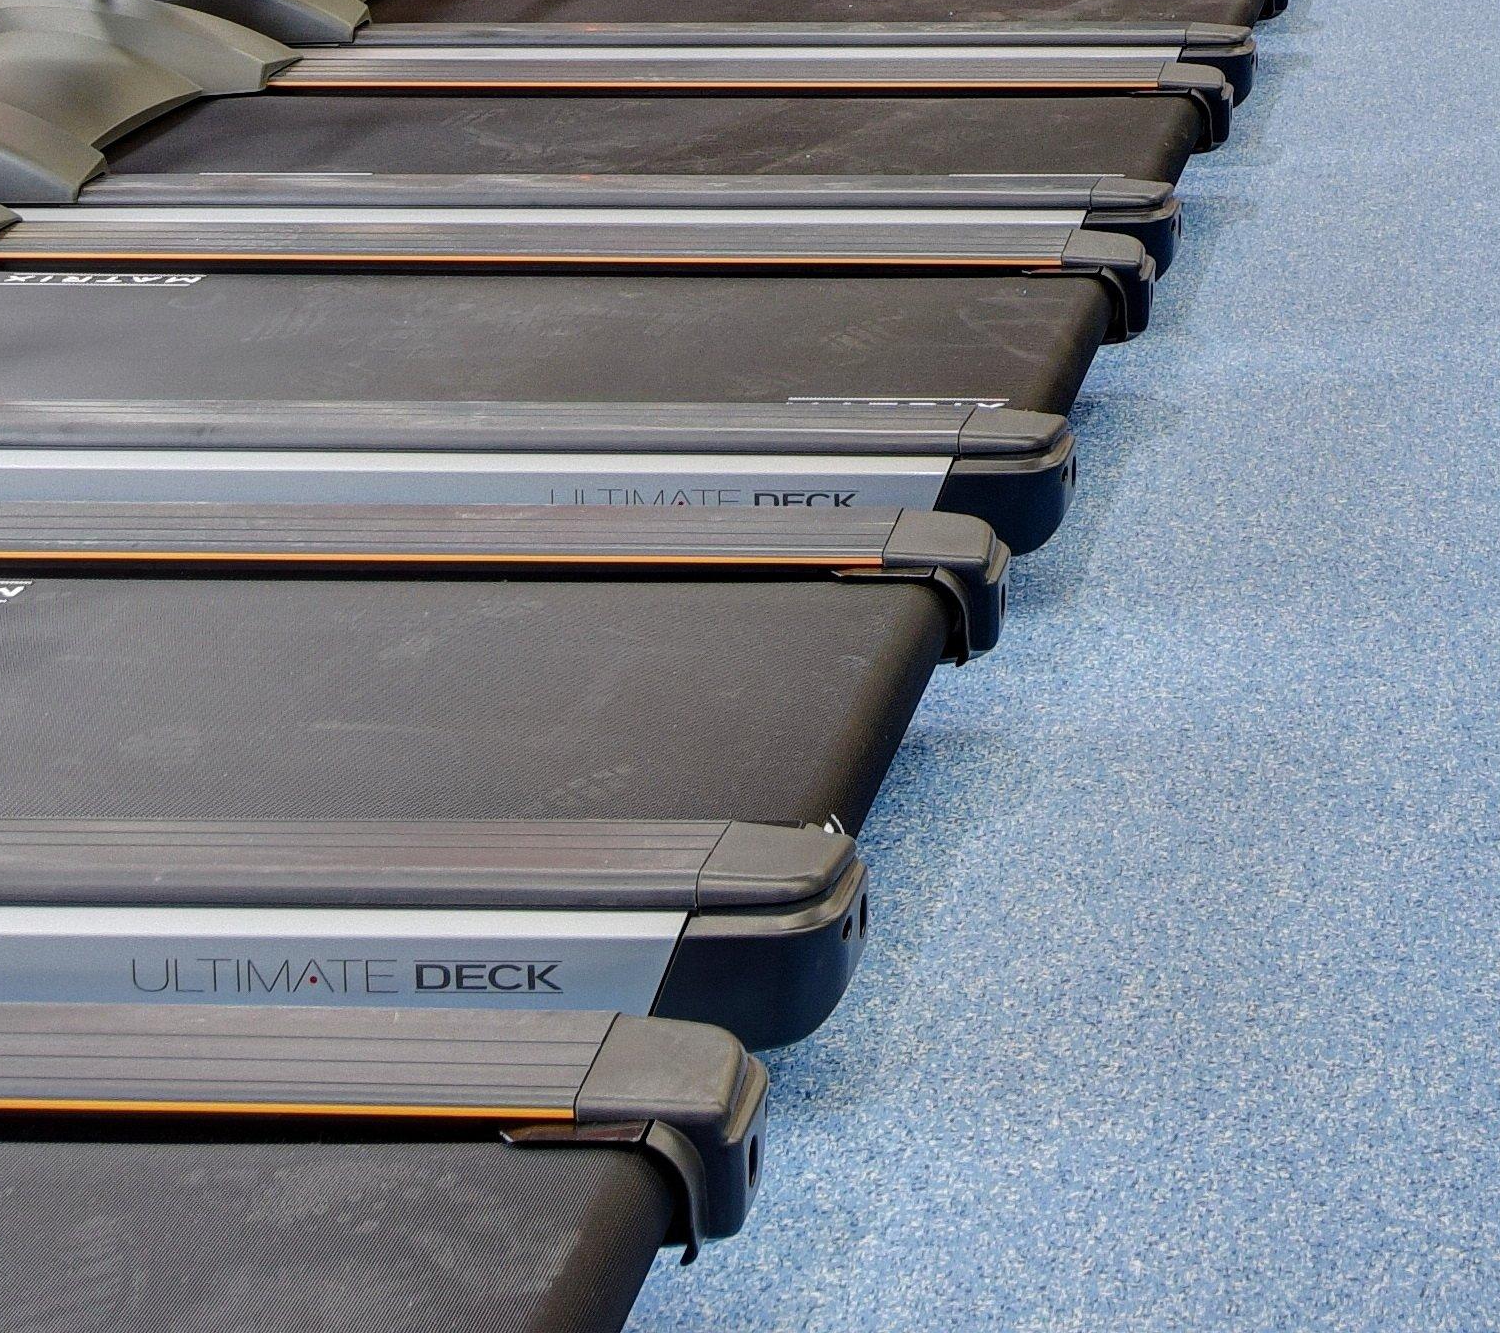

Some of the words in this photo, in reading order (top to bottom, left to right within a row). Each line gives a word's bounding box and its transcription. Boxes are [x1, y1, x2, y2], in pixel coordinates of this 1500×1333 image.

[3, 275, 202, 284] MATRIX
[131, 957, 399, 995] ULTIMATE
[413, 962, 564, 993] DECK
